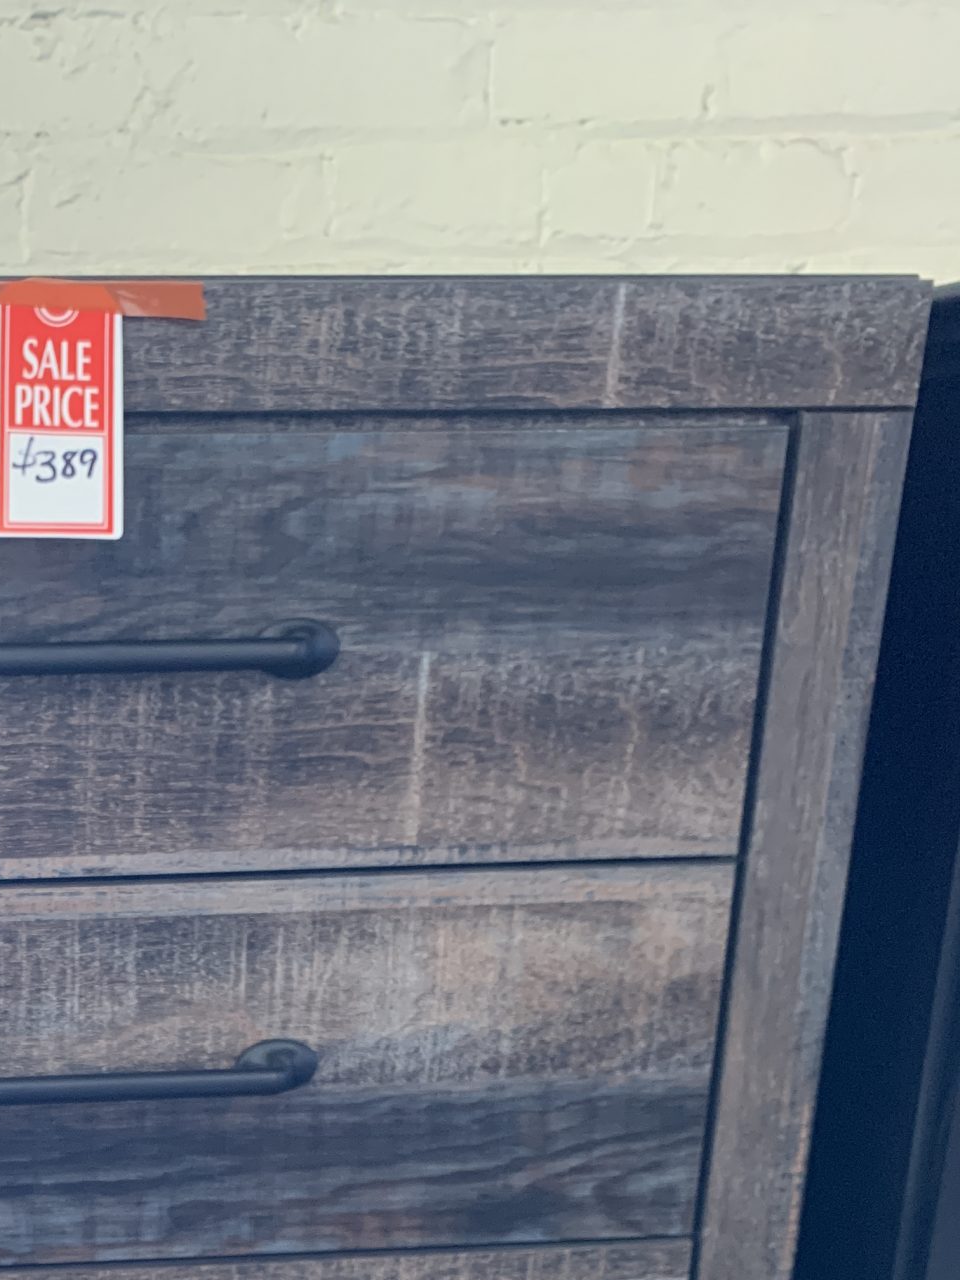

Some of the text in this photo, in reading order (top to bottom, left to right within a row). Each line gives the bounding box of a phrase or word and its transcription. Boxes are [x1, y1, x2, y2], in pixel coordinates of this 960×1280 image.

[22, 337, 92, 381] SALE
[14, 384, 100, 428] PRICE
[12, 437, 98, 482] $389
